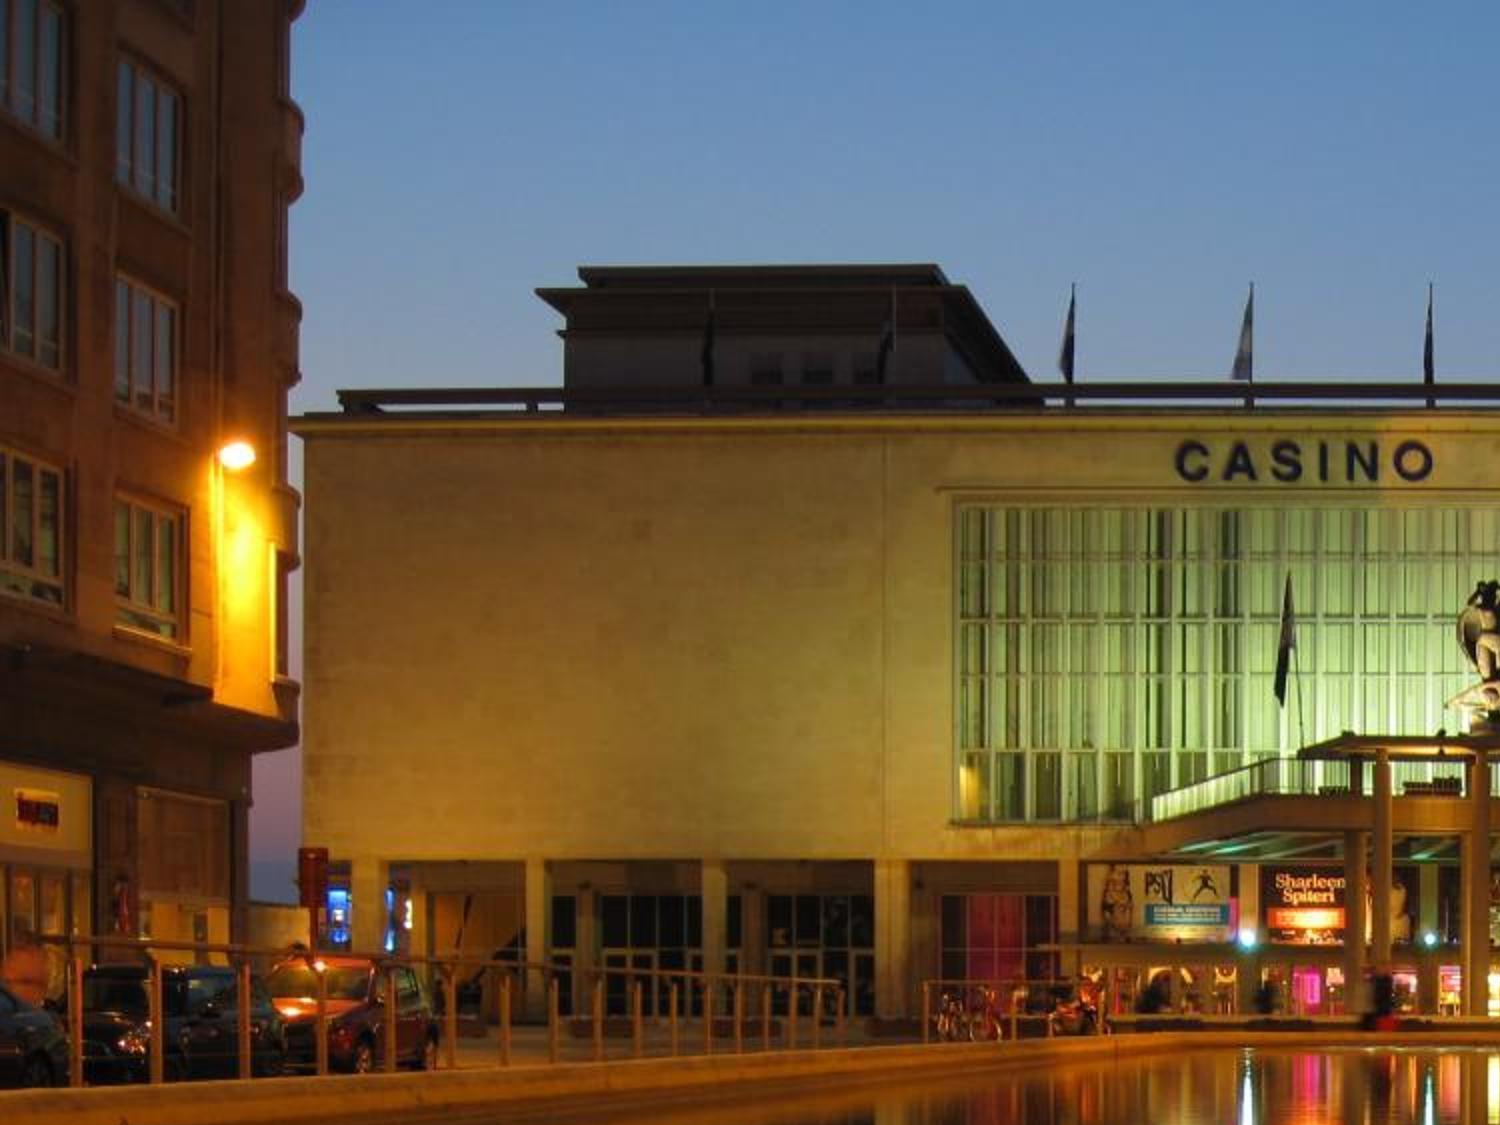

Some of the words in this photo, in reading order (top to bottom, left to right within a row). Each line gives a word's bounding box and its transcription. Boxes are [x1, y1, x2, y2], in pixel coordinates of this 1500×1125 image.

[1175, 440, 1434, 483] CASINO
[1275, 873, 1346, 889] Sharleen
[1283, 887, 1336, 906] Spiteri
